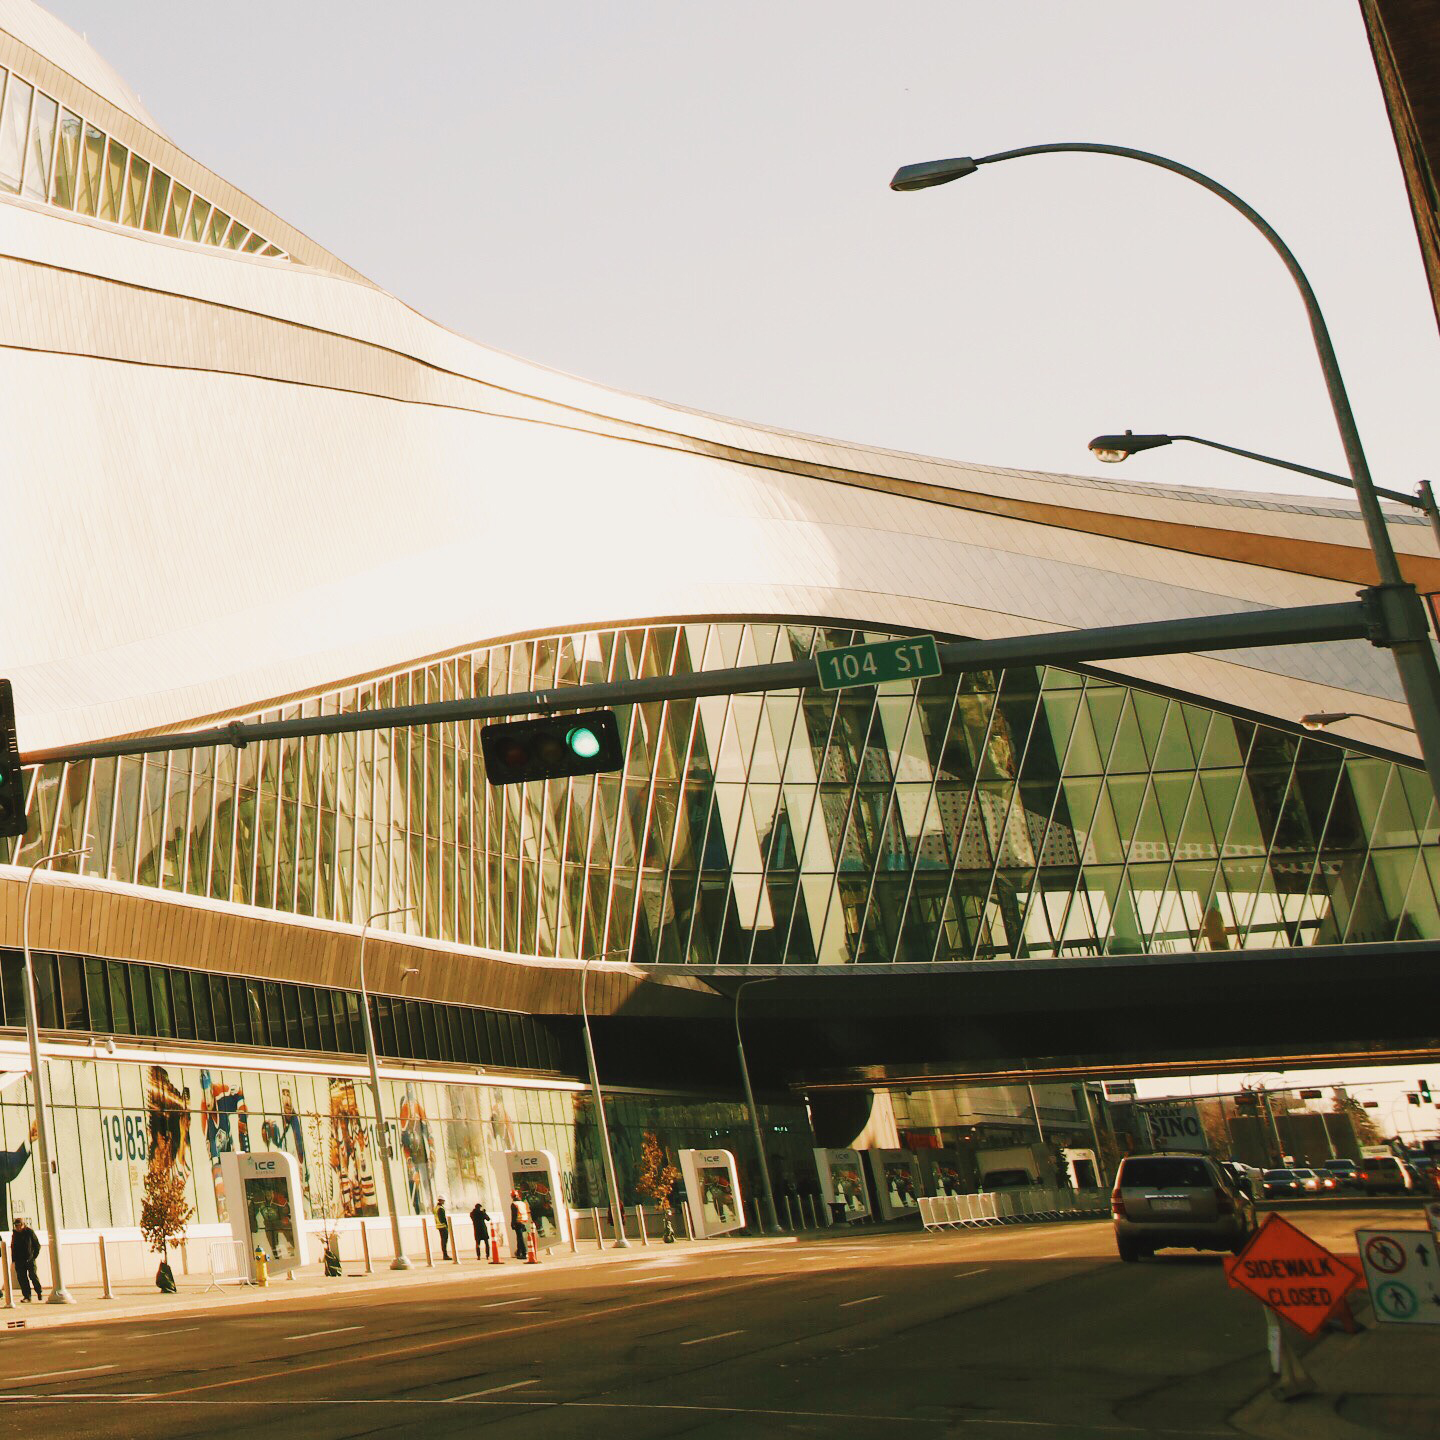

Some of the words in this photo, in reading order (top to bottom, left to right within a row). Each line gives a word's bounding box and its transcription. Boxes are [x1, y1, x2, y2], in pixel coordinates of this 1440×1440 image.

[829, 651, 878, 680] 104
[894, 644, 925, 672] ST
[1151, 1116, 1200, 1137] SINO
[103, 1114, 146, 1161] 1985
[1245, 1258, 1335, 1279] SIDEWALK
[1268, 1287, 1333, 1307] CLOSED
